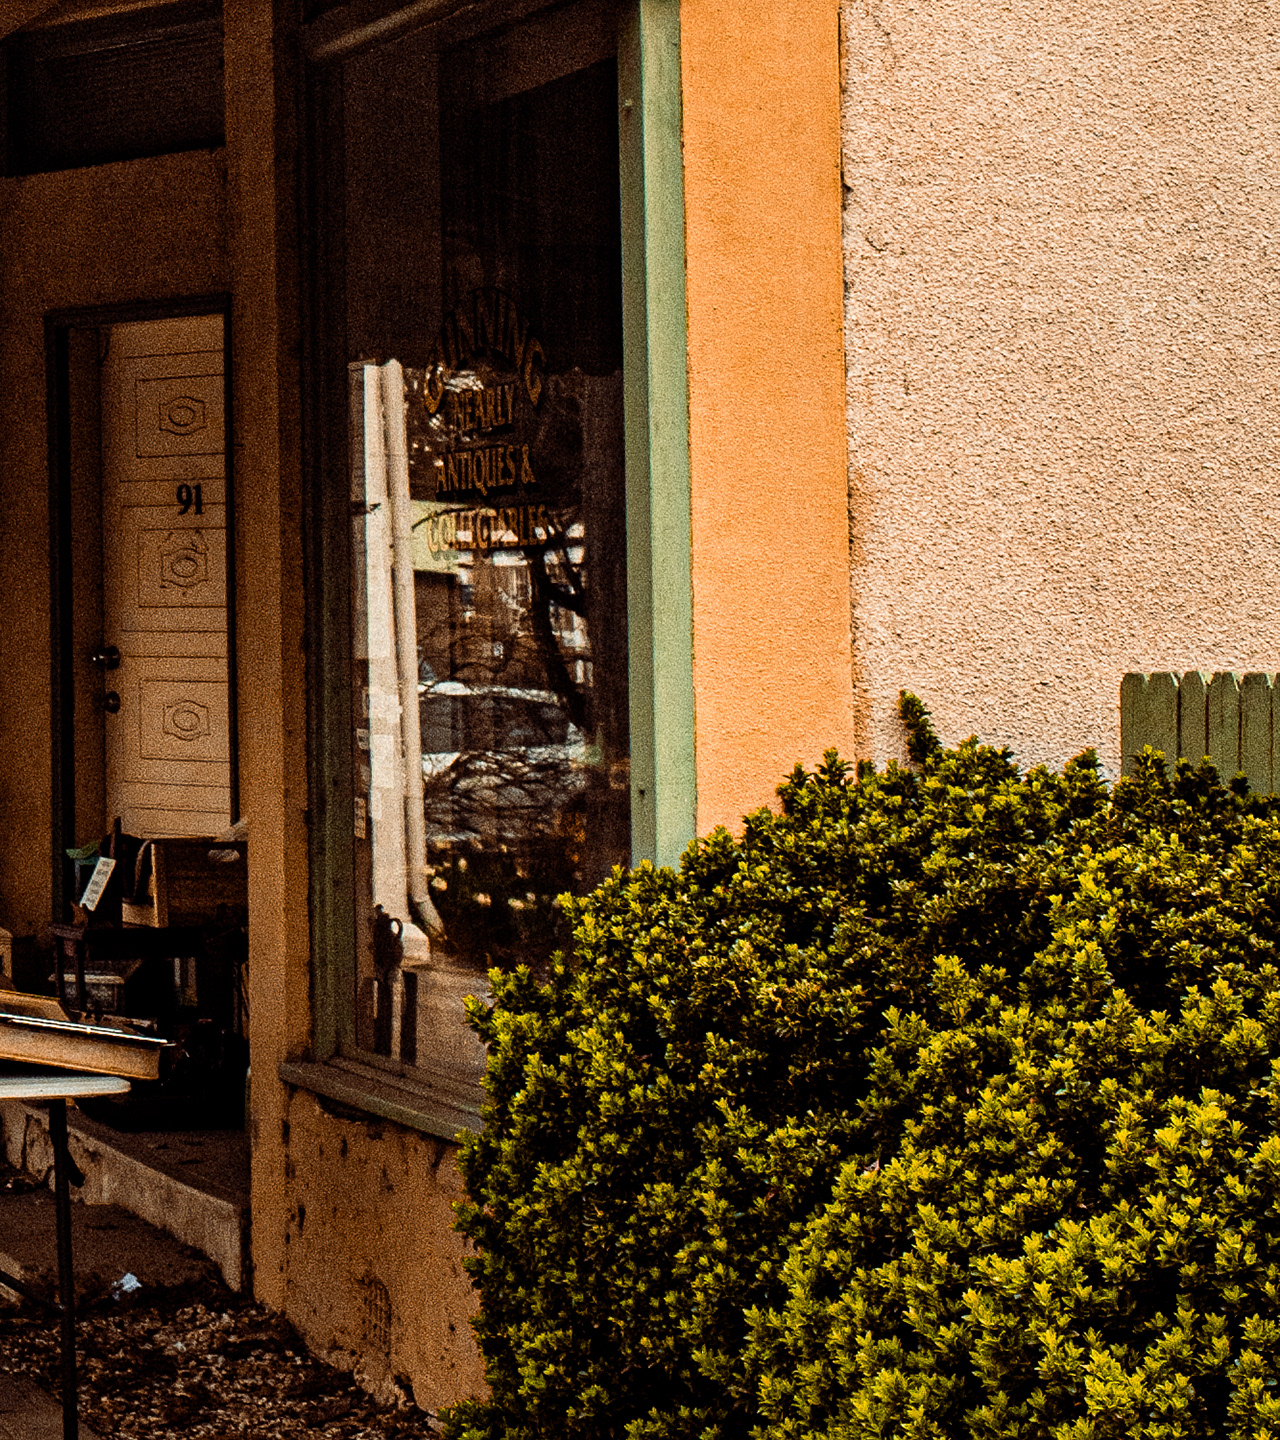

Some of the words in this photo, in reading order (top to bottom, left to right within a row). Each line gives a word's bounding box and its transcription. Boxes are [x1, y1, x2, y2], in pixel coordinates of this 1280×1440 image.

[423, 288, 547, 413] GUNNING
[437, 445, 516, 496] ANTIQUES
[520, 444, 536, 484] &
[176, 484, 205, 515] 91
[427, 504, 549, 553] COLLECTABLES
